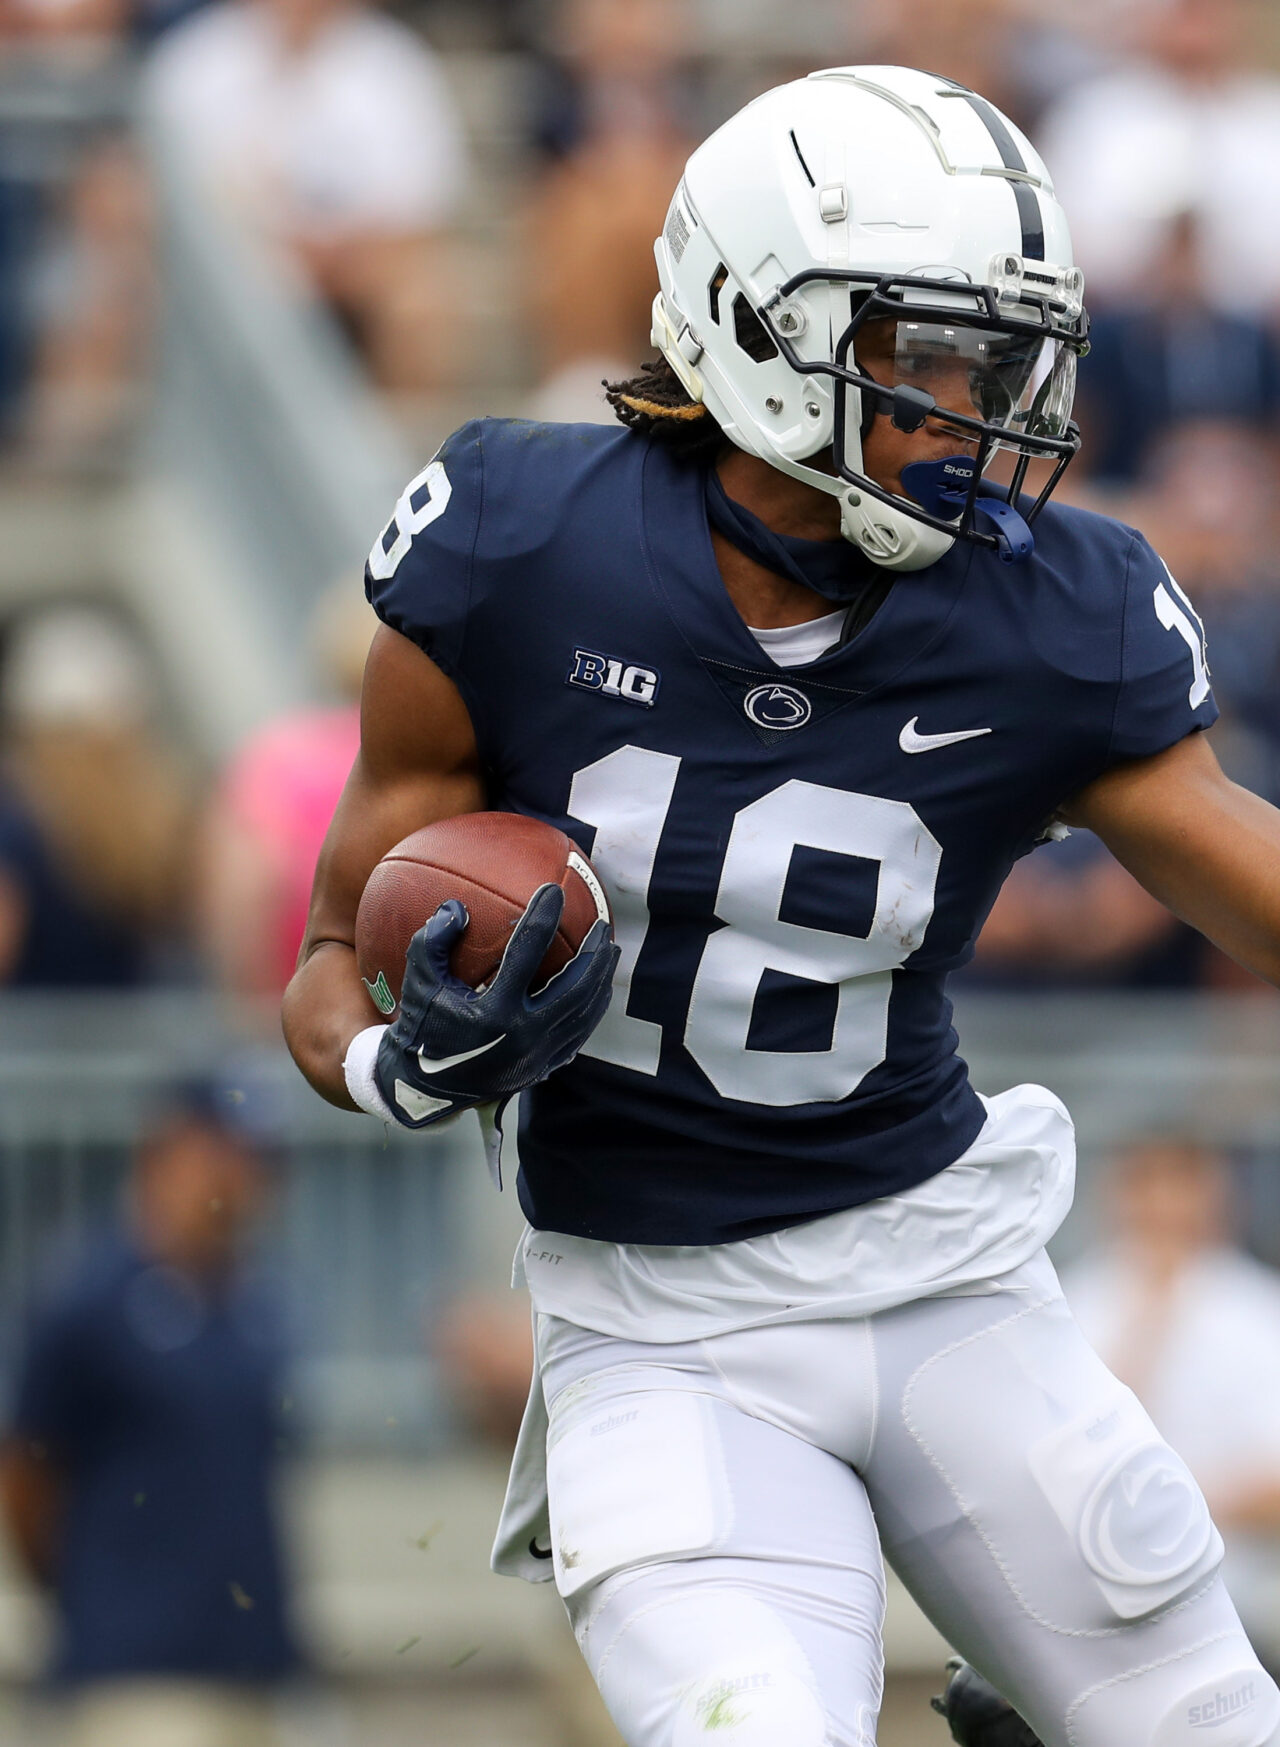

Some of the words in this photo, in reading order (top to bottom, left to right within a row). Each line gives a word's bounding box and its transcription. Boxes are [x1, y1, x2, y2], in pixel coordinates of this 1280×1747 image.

[369, 440, 453, 581] 8
[1153, 556, 1211, 711] 1
[567, 744, 943, 1107] 18
[1187, 1681, 1257, 1728] schutt
